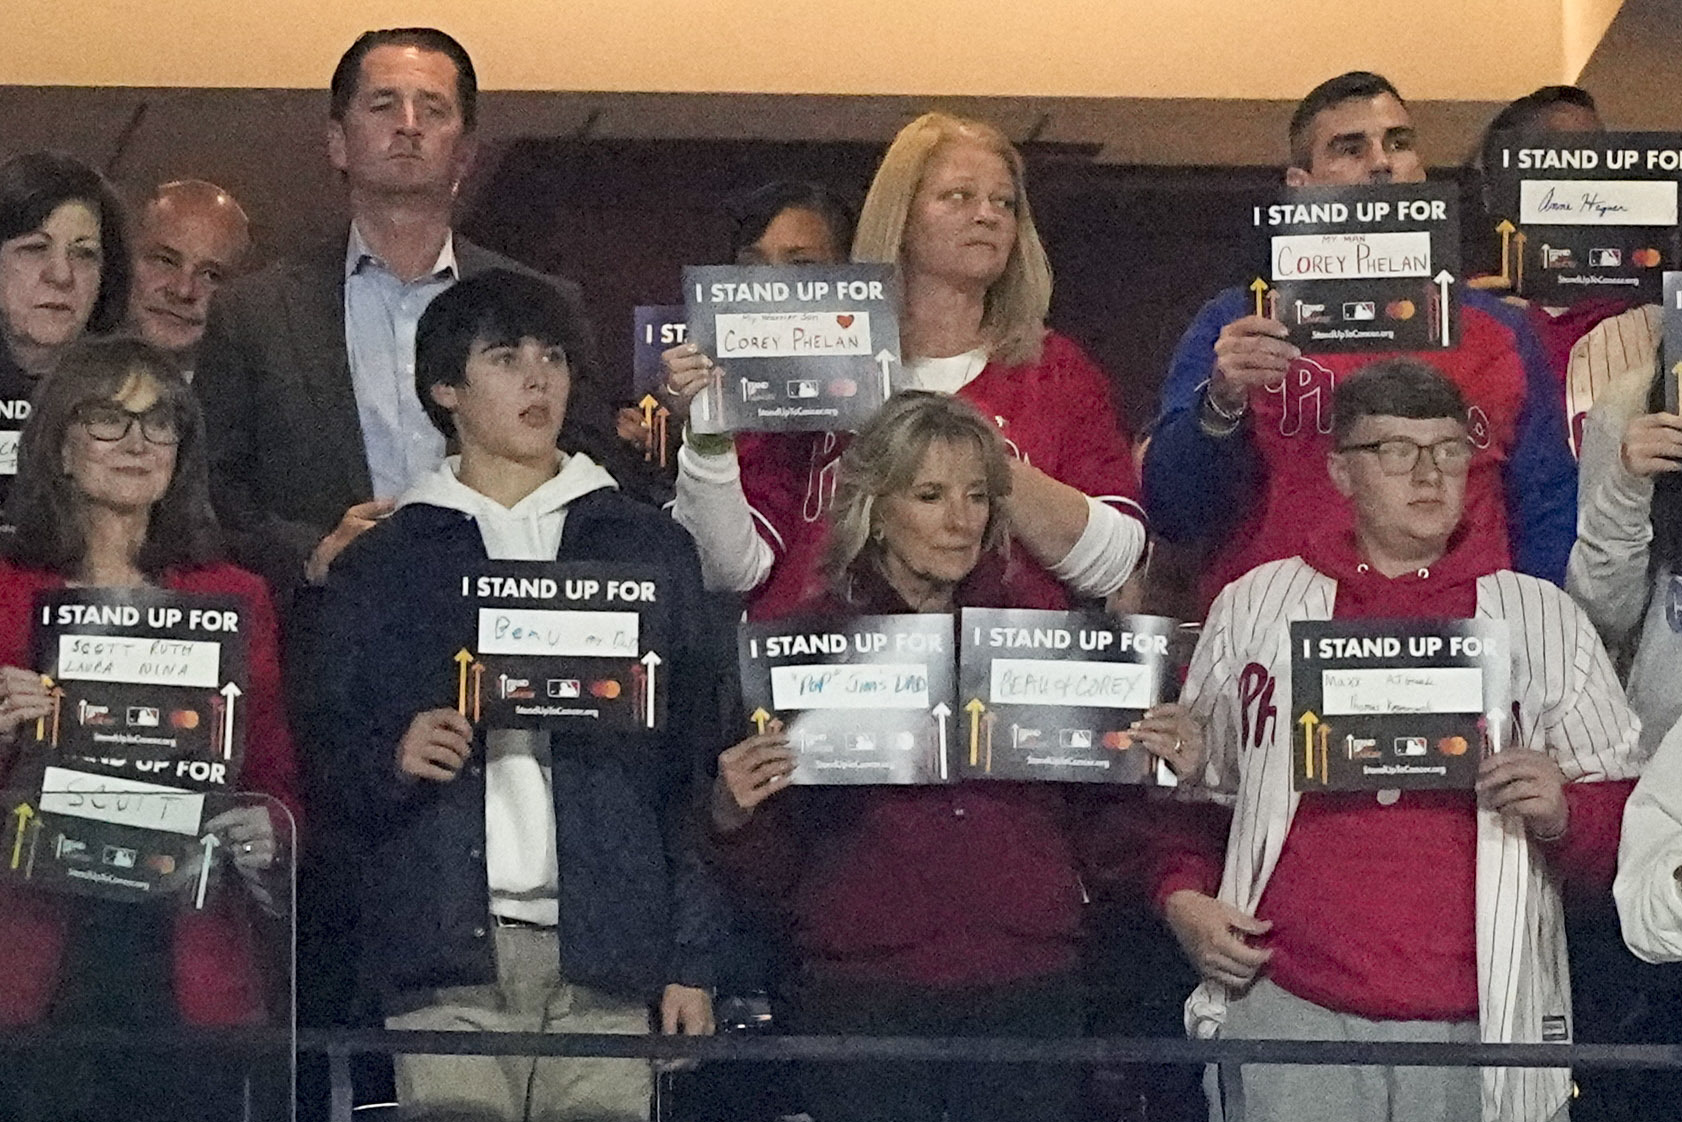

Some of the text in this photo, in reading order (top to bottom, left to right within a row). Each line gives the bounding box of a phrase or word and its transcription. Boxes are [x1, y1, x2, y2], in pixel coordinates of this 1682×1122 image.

[1503, 149, 1510, 169] I
[1518, 149, 1599, 170] STAND
[1606, 150, 1639, 170] UP
[1254, 200, 1447, 226] I STAND UP FOR
[695, 281, 884, 303] I STAND UP FOR
[1676, 290, 1682, 310] I
[462, 576, 656, 602] I STAND UP FOR
[42, 605, 239, 633] I STAND UP FOR
[750, 633, 944, 659] I STAND UP FOR
[974, 627, 1169, 655] I STAND UP FOR
[1303, 636, 1498, 659] I STAND UP FOR
[138, 663, 189, 676] NINA
[176, 760, 226, 785] FOR
